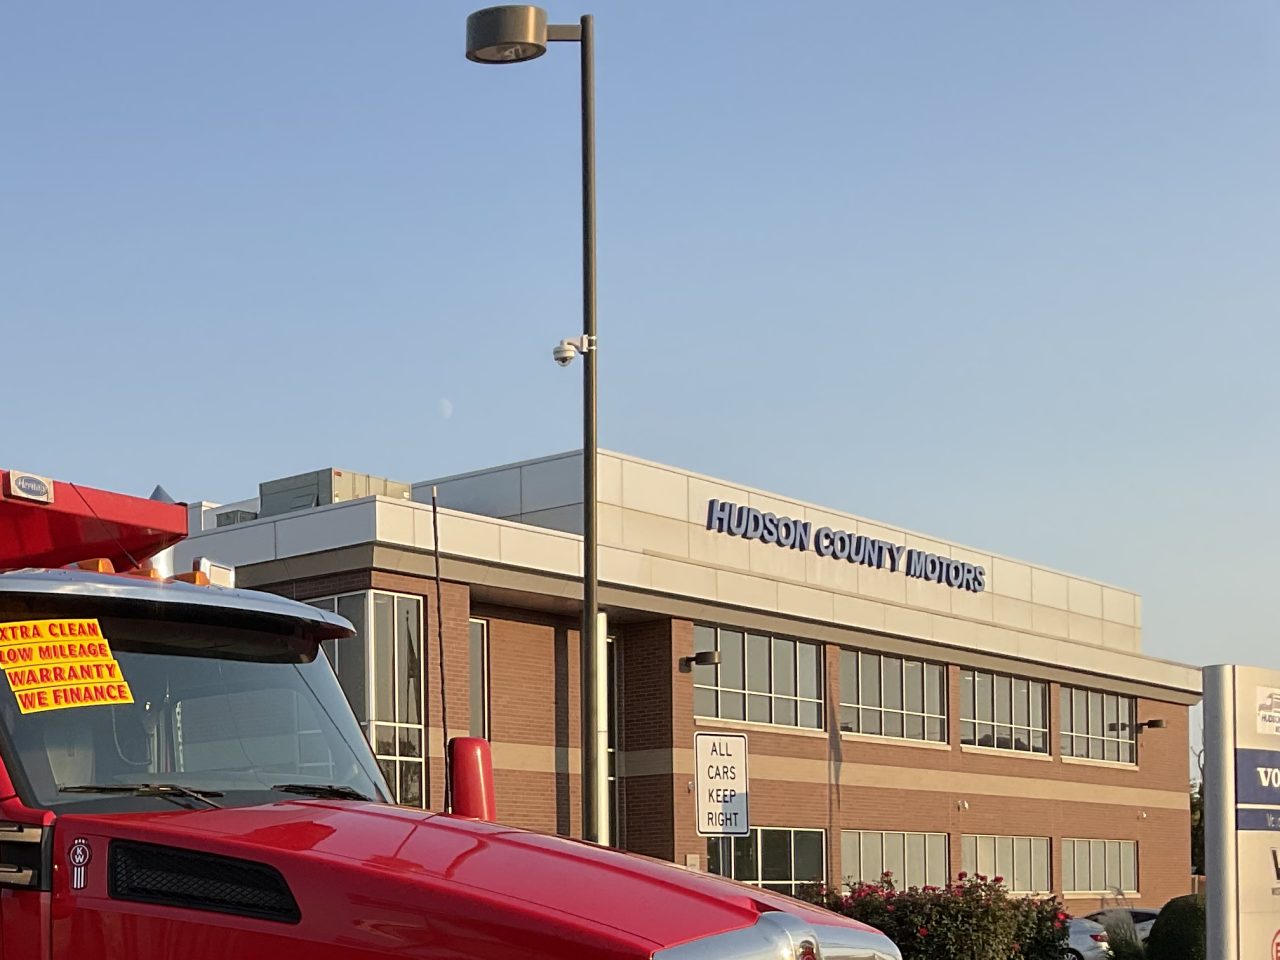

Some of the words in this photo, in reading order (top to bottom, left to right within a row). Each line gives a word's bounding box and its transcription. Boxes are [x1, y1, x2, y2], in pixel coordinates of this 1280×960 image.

[706, 498, 811, 551] HUDSON
[814, 526, 907, 572] COUNTY
[906, 548, 986, 593] MOTORS
[48, 622, 99, 638] CLEAN
[39, 643, 109, 661] MILEAGE
[8, 663, 116, 687] WARRANTY
[18, 691, 48, 709] WE
[53, 684, 129, 705] FINANCE
[710, 742, 732, 756] ALL
[708, 765, 736, 780] CARS
[708, 788, 736, 803] KEEP
[707, 812, 739, 827] RIGHT
